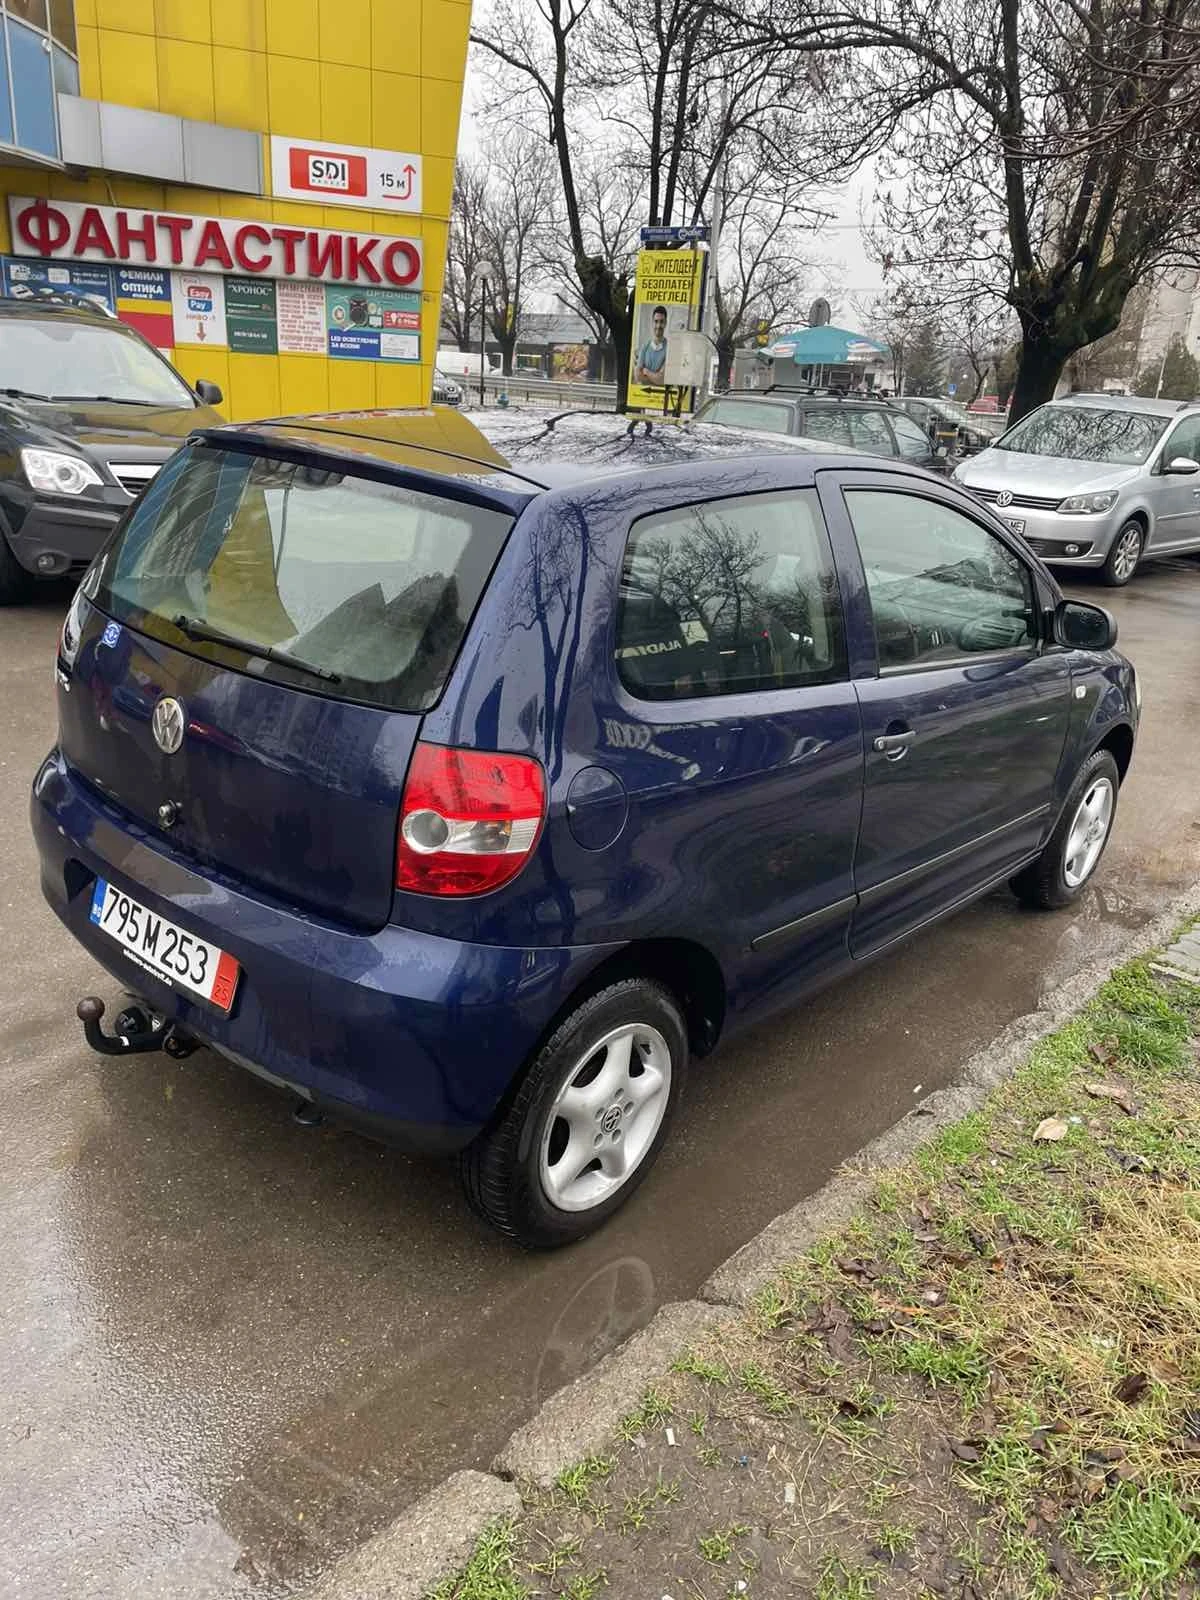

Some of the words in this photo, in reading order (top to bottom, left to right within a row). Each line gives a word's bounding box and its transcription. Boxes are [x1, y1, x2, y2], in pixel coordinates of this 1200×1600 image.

[312, 159, 346, 181] SDI
[379, 173, 394, 188] 15
[17, 199, 421, 286] ФАНТАСТИКО
[119, 270, 164, 281] ФЕМИЛИ
[121, 282, 164, 295] ОПТИКА
[646, 290, 688, 303] ПРЕГЛЕД
[191, 300, 206, 310] Pay
